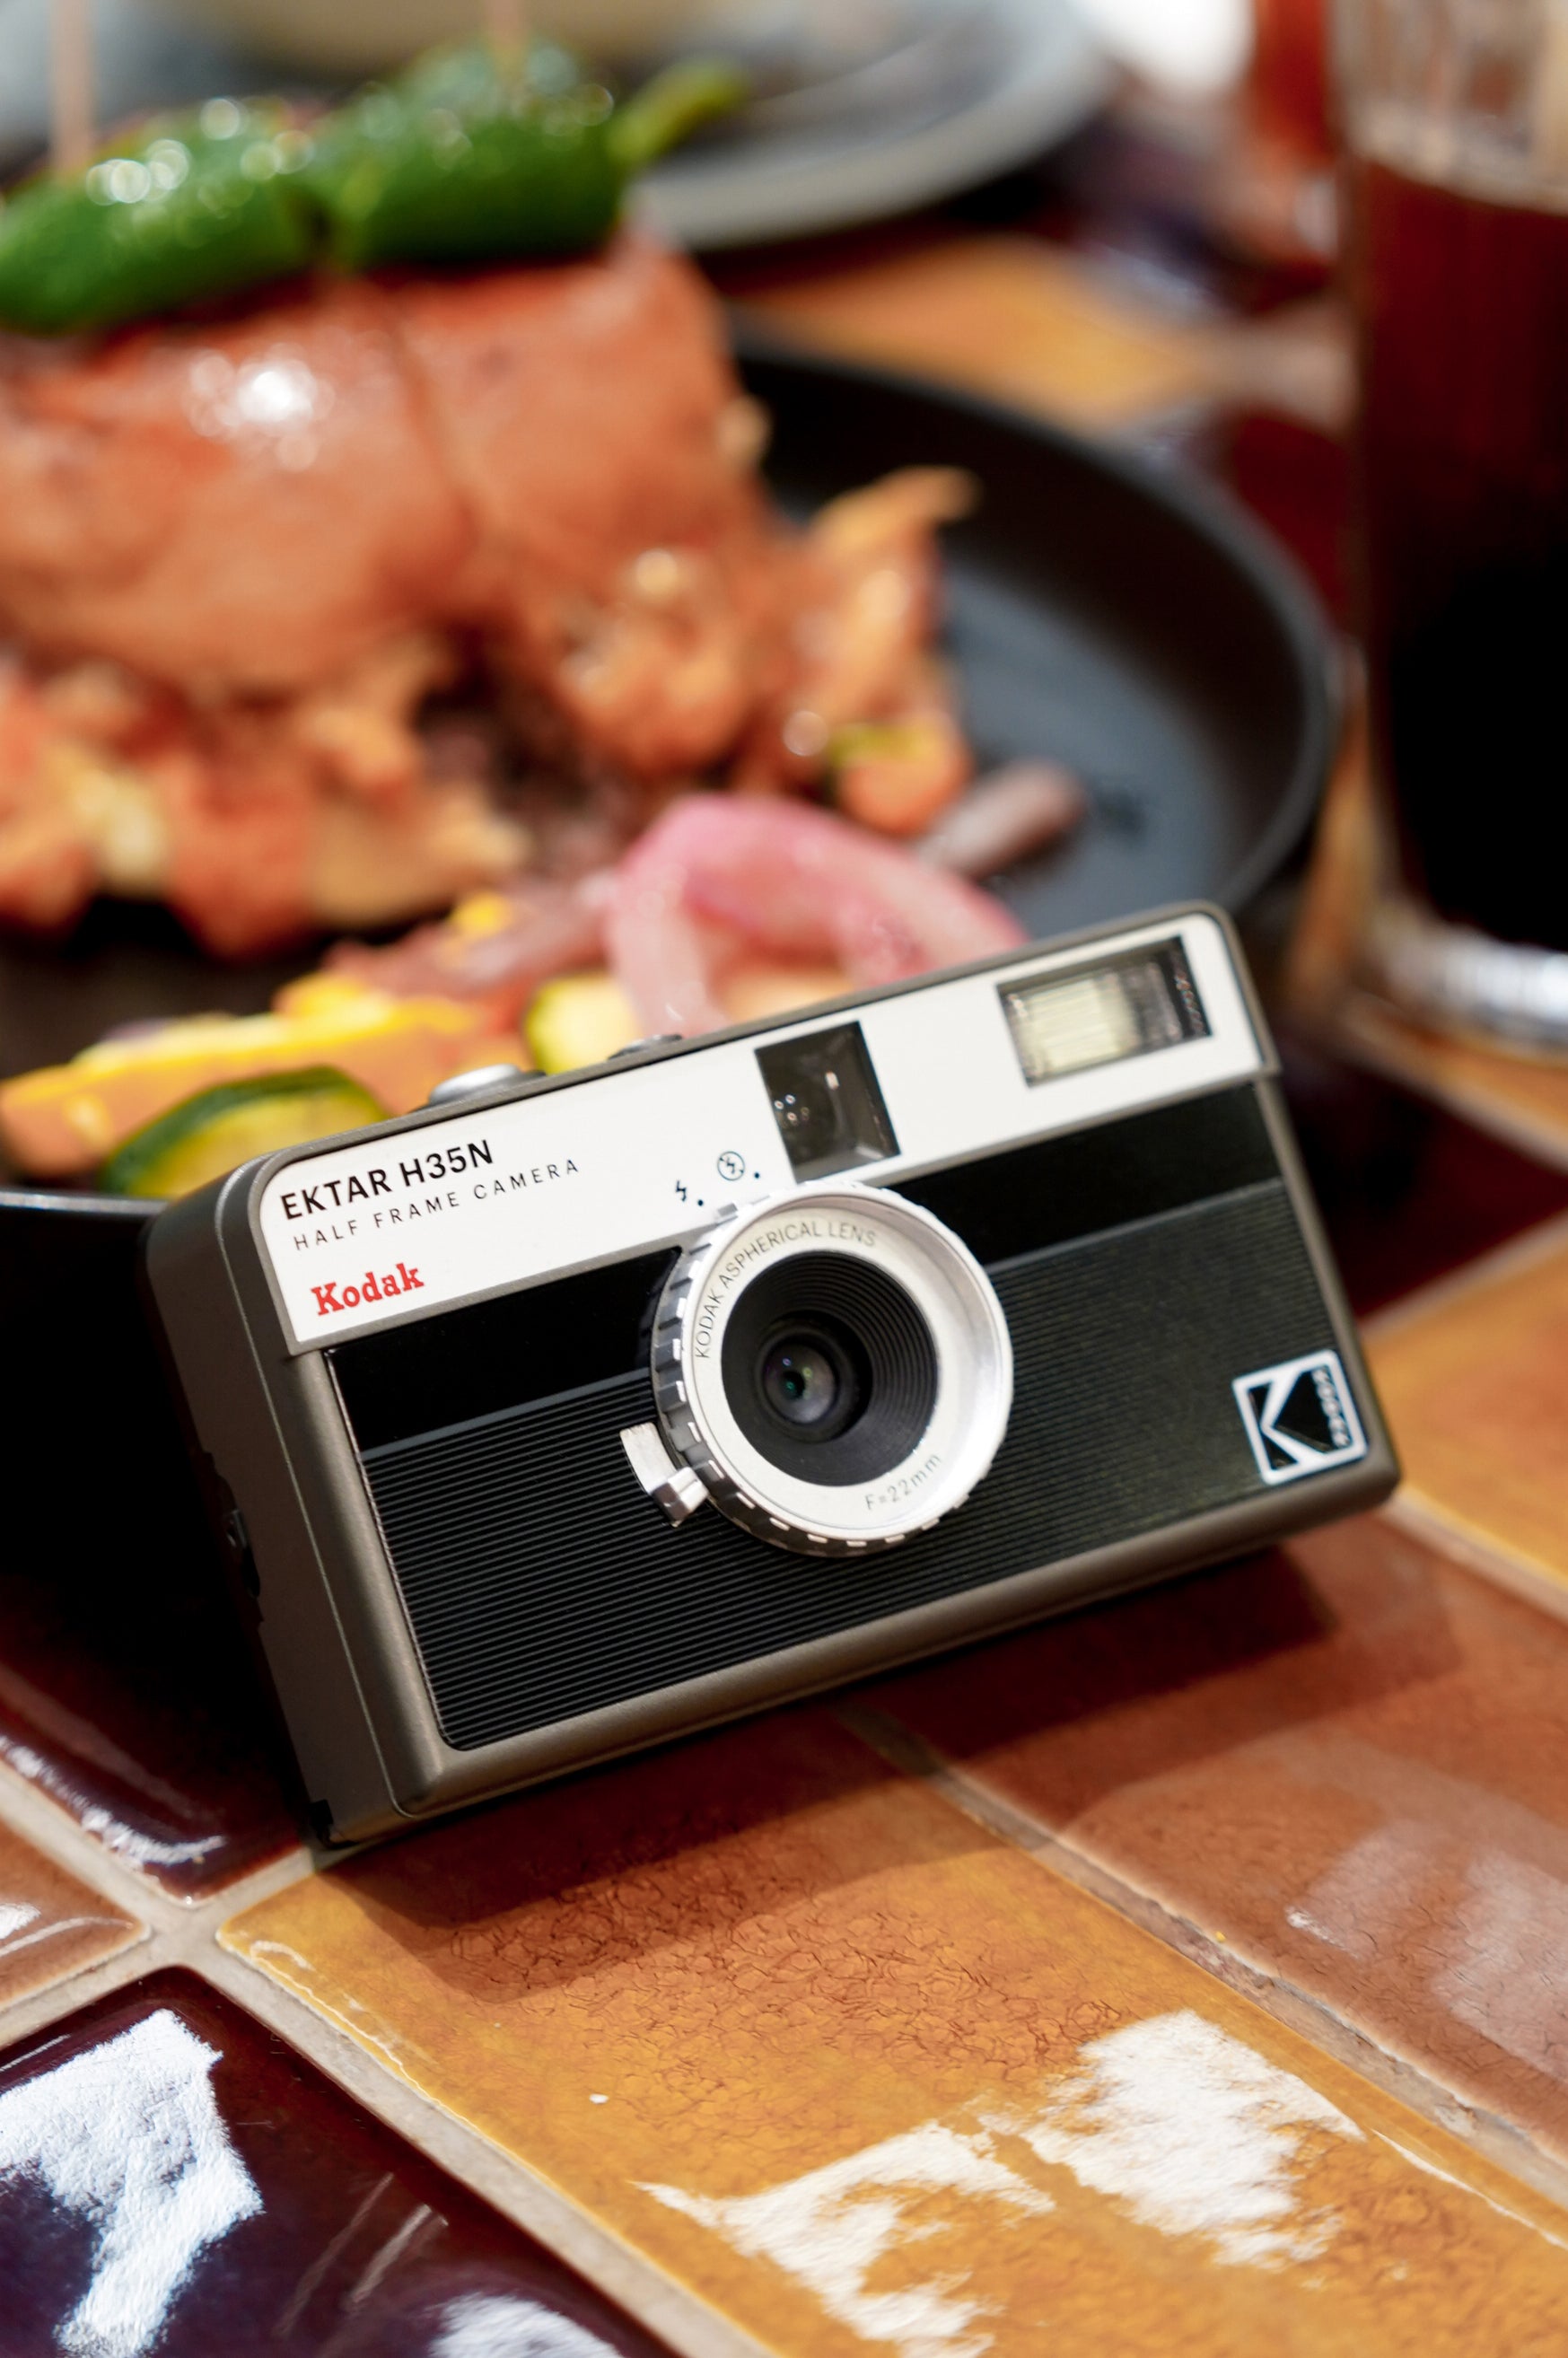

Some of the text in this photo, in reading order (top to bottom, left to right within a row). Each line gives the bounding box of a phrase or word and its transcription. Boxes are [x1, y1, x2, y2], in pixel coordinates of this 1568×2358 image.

[280, 1139, 494, 1220] EKTAR H35N
[293, 1159, 579, 1250] HALF FRAME CAMERA
[311, 1262, 425, 1316] Kodak
[696, 1221, 877, 1359] KODAK ASPHERICAL LENS
[865, 1454, 941, 1510] F=22mm
